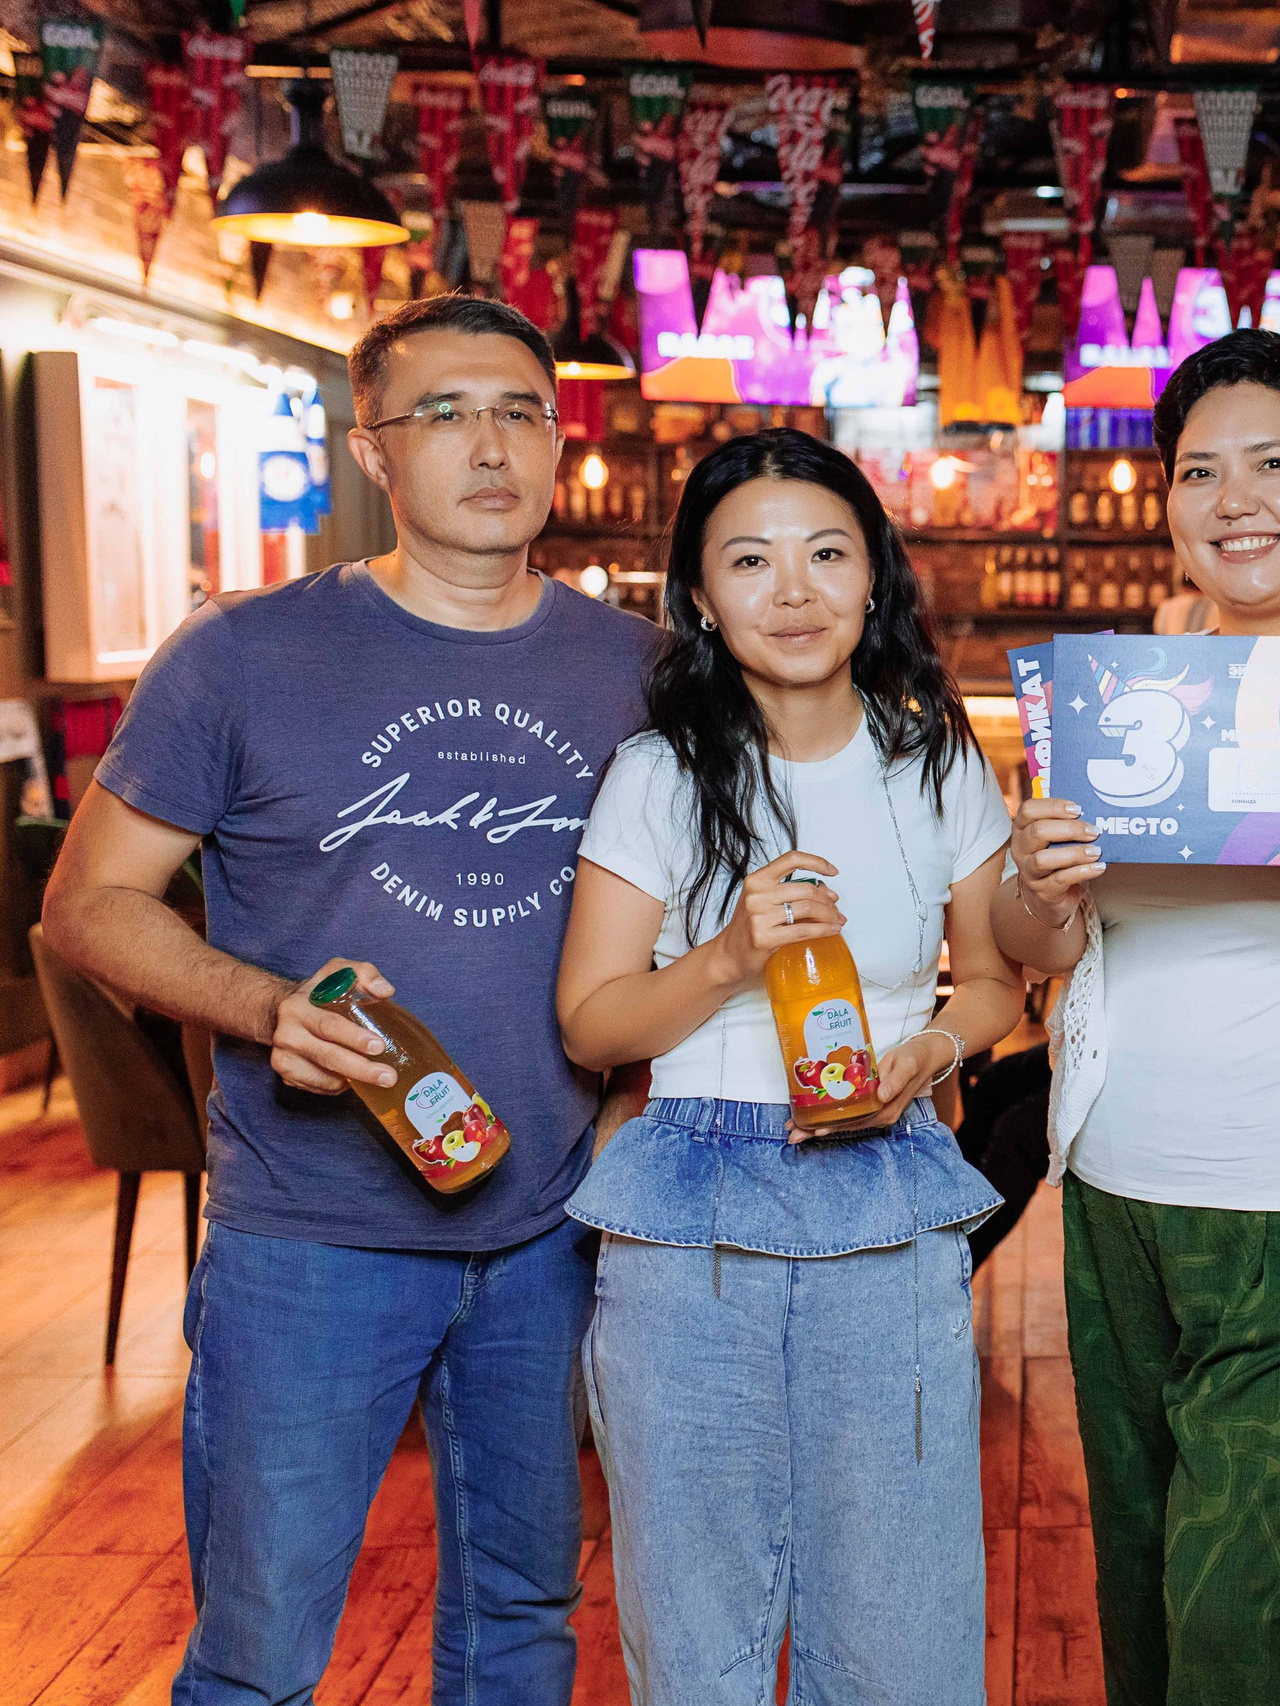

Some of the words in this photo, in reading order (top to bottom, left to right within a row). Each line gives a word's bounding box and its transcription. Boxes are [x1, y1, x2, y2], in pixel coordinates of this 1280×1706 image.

[361, 698, 482, 768] SUPERIOR
[494, 703, 594, 779] QUALITY
[1087, 688, 1191, 808] 3
[437, 751, 526, 765] established
[319, 772, 480, 852] Jack
[1096, 817, 1179, 837] МЕСТО
[455, 872, 505, 886] 1990
[370, 862, 444, 921] DENIM
[453, 891, 542, 927] SUPPLY
[827, 1008, 849, 1020] DALA
[829, 1017, 852, 1030] FRUIT
[423, 1078, 444, 1099] DALA
[429, 1084, 451, 1106] FRUIT
